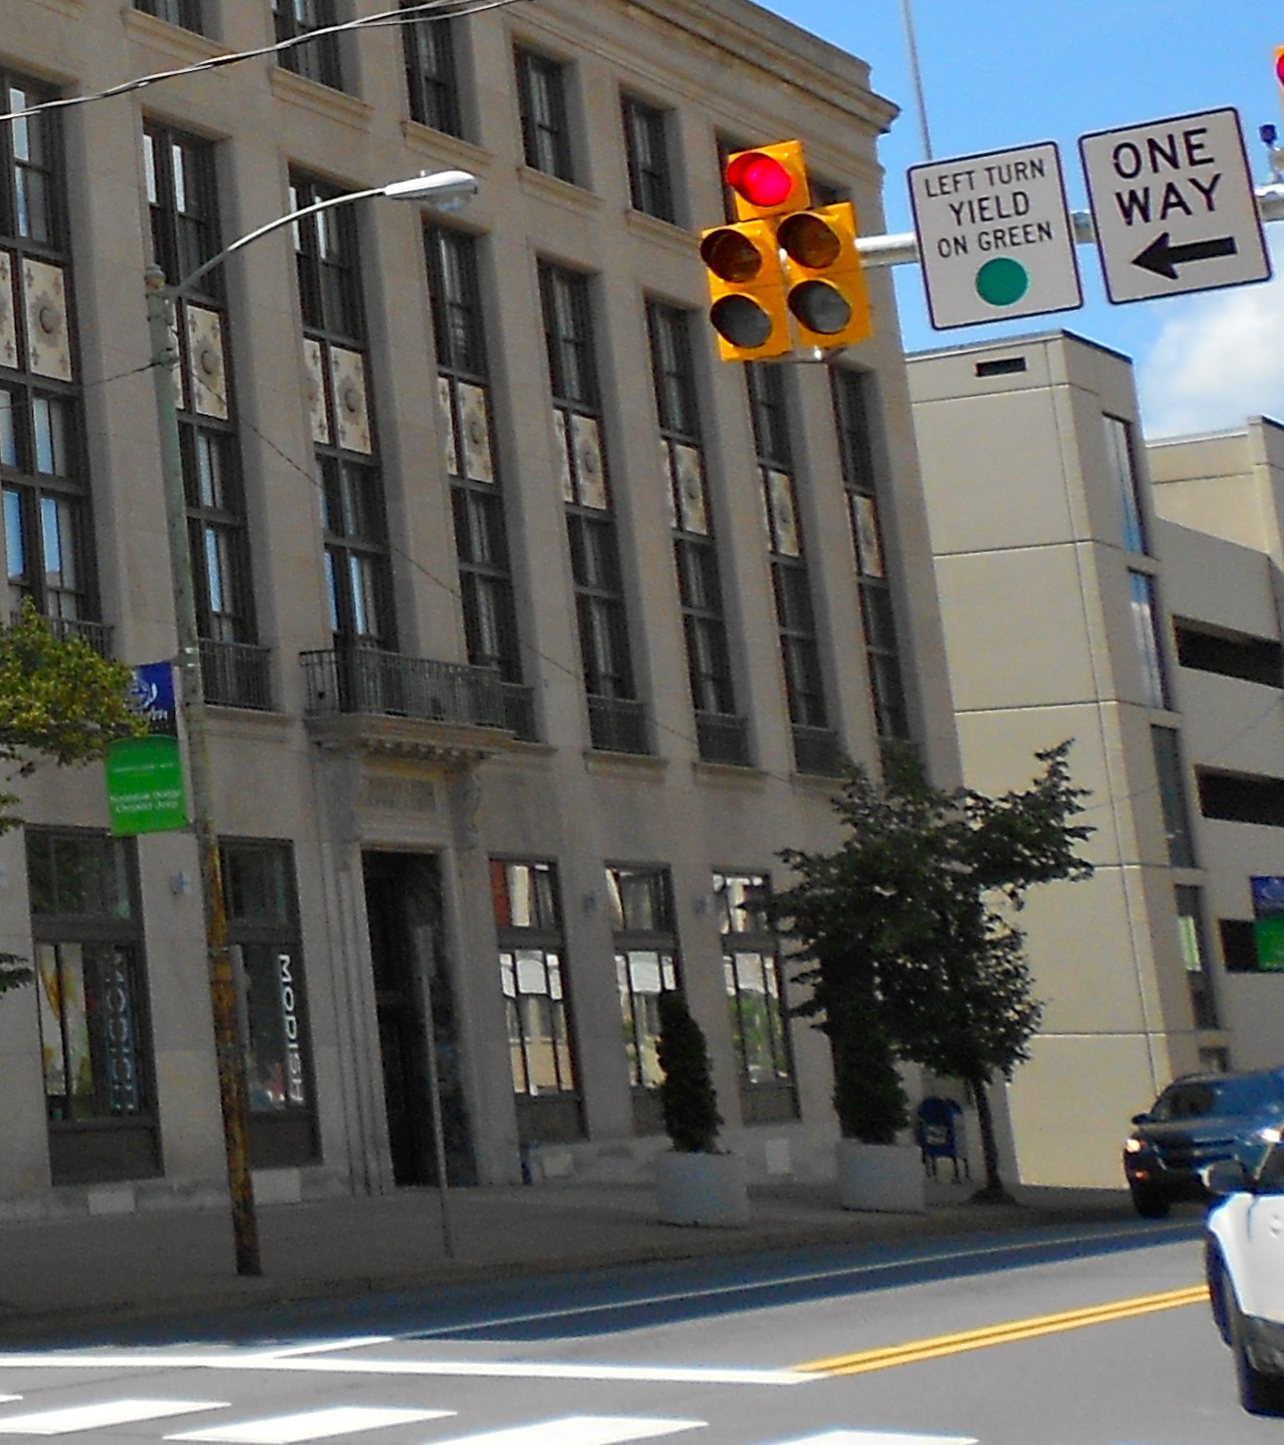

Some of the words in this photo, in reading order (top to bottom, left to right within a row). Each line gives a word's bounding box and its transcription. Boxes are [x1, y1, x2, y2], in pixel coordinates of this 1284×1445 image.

[1112, 128, 1215, 179] ONE
[924, 170, 975, 198] LEFT
[985, 158, 1045, 188] TURN
[1114, 173, 1221, 226] WAY
[949, 191, 1030, 226] YIELD
[937, 234, 968, 258] ON
[978, 220, 1053, 252] GREEN
[278, 954, 304, 1103] MODISH
